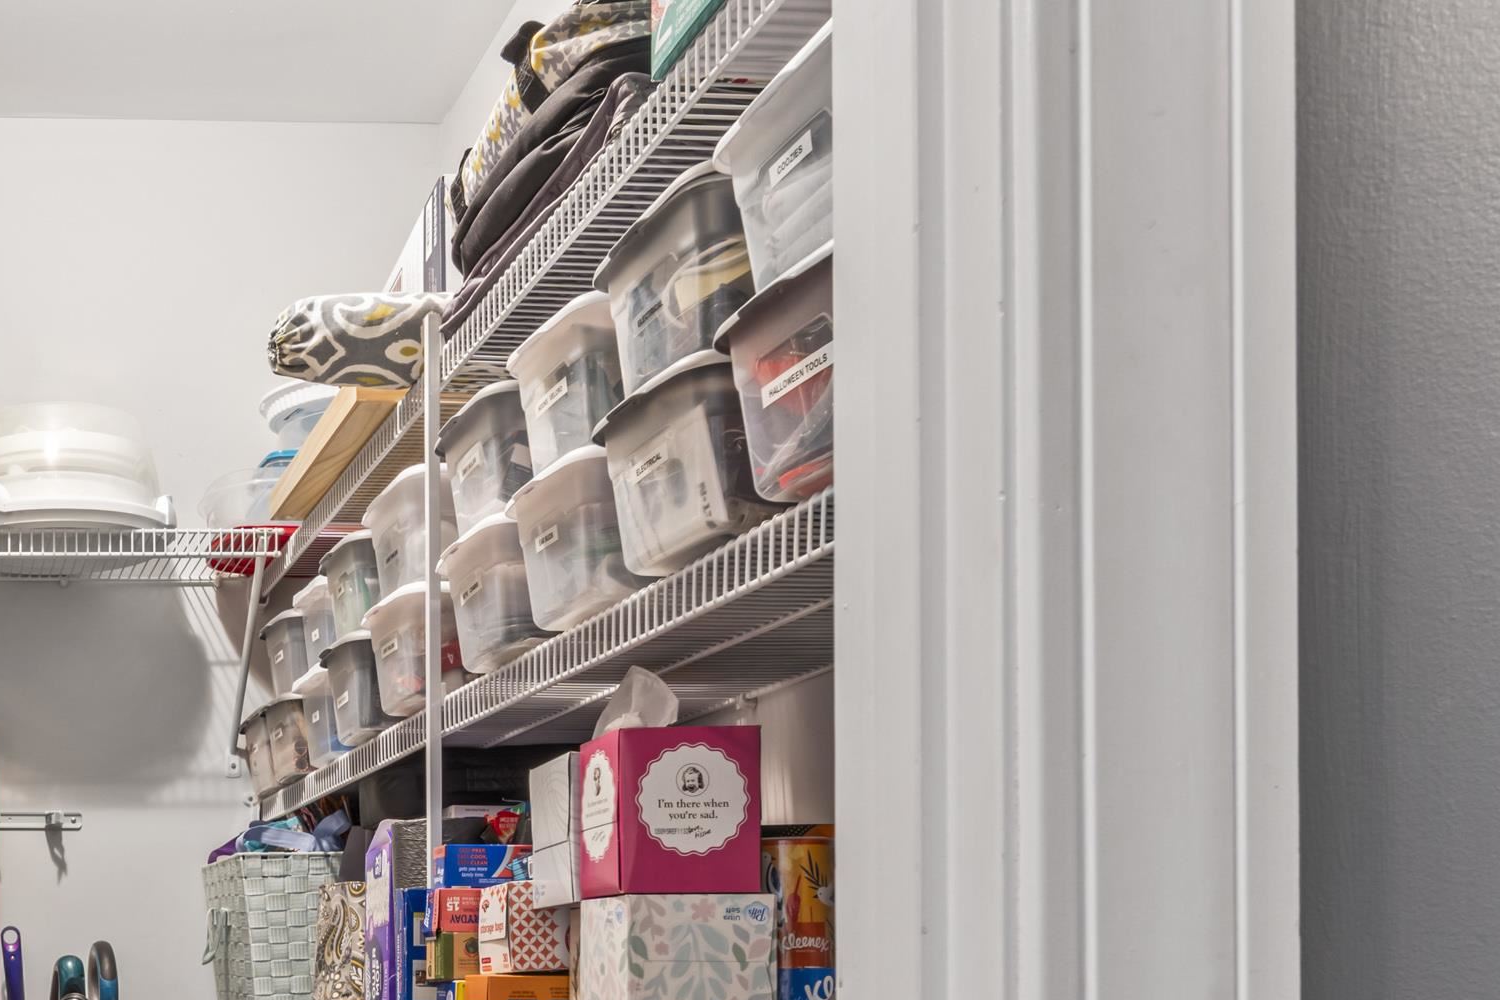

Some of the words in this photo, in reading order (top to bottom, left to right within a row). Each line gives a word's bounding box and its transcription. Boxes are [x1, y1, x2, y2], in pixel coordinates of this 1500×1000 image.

[776, 144, 803, 174] COOZIES
[768, 368, 804, 398] HALLOWEEN
[804, 353, 828, 375] TOOLS
[636, 452, 662, 478] ELECTRICAL
[658, 800, 674, 808] I'm
[676, 799, 700, 808] there
[703, 799, 730, 808] when
[668, 812, 698, 820] you're
[700, 810, 718, 820] sad.
[446, 901, 460, 911] 15
[748, 907, 766, 922] Puffs
[782, 933, 828, 954] Kleenex
